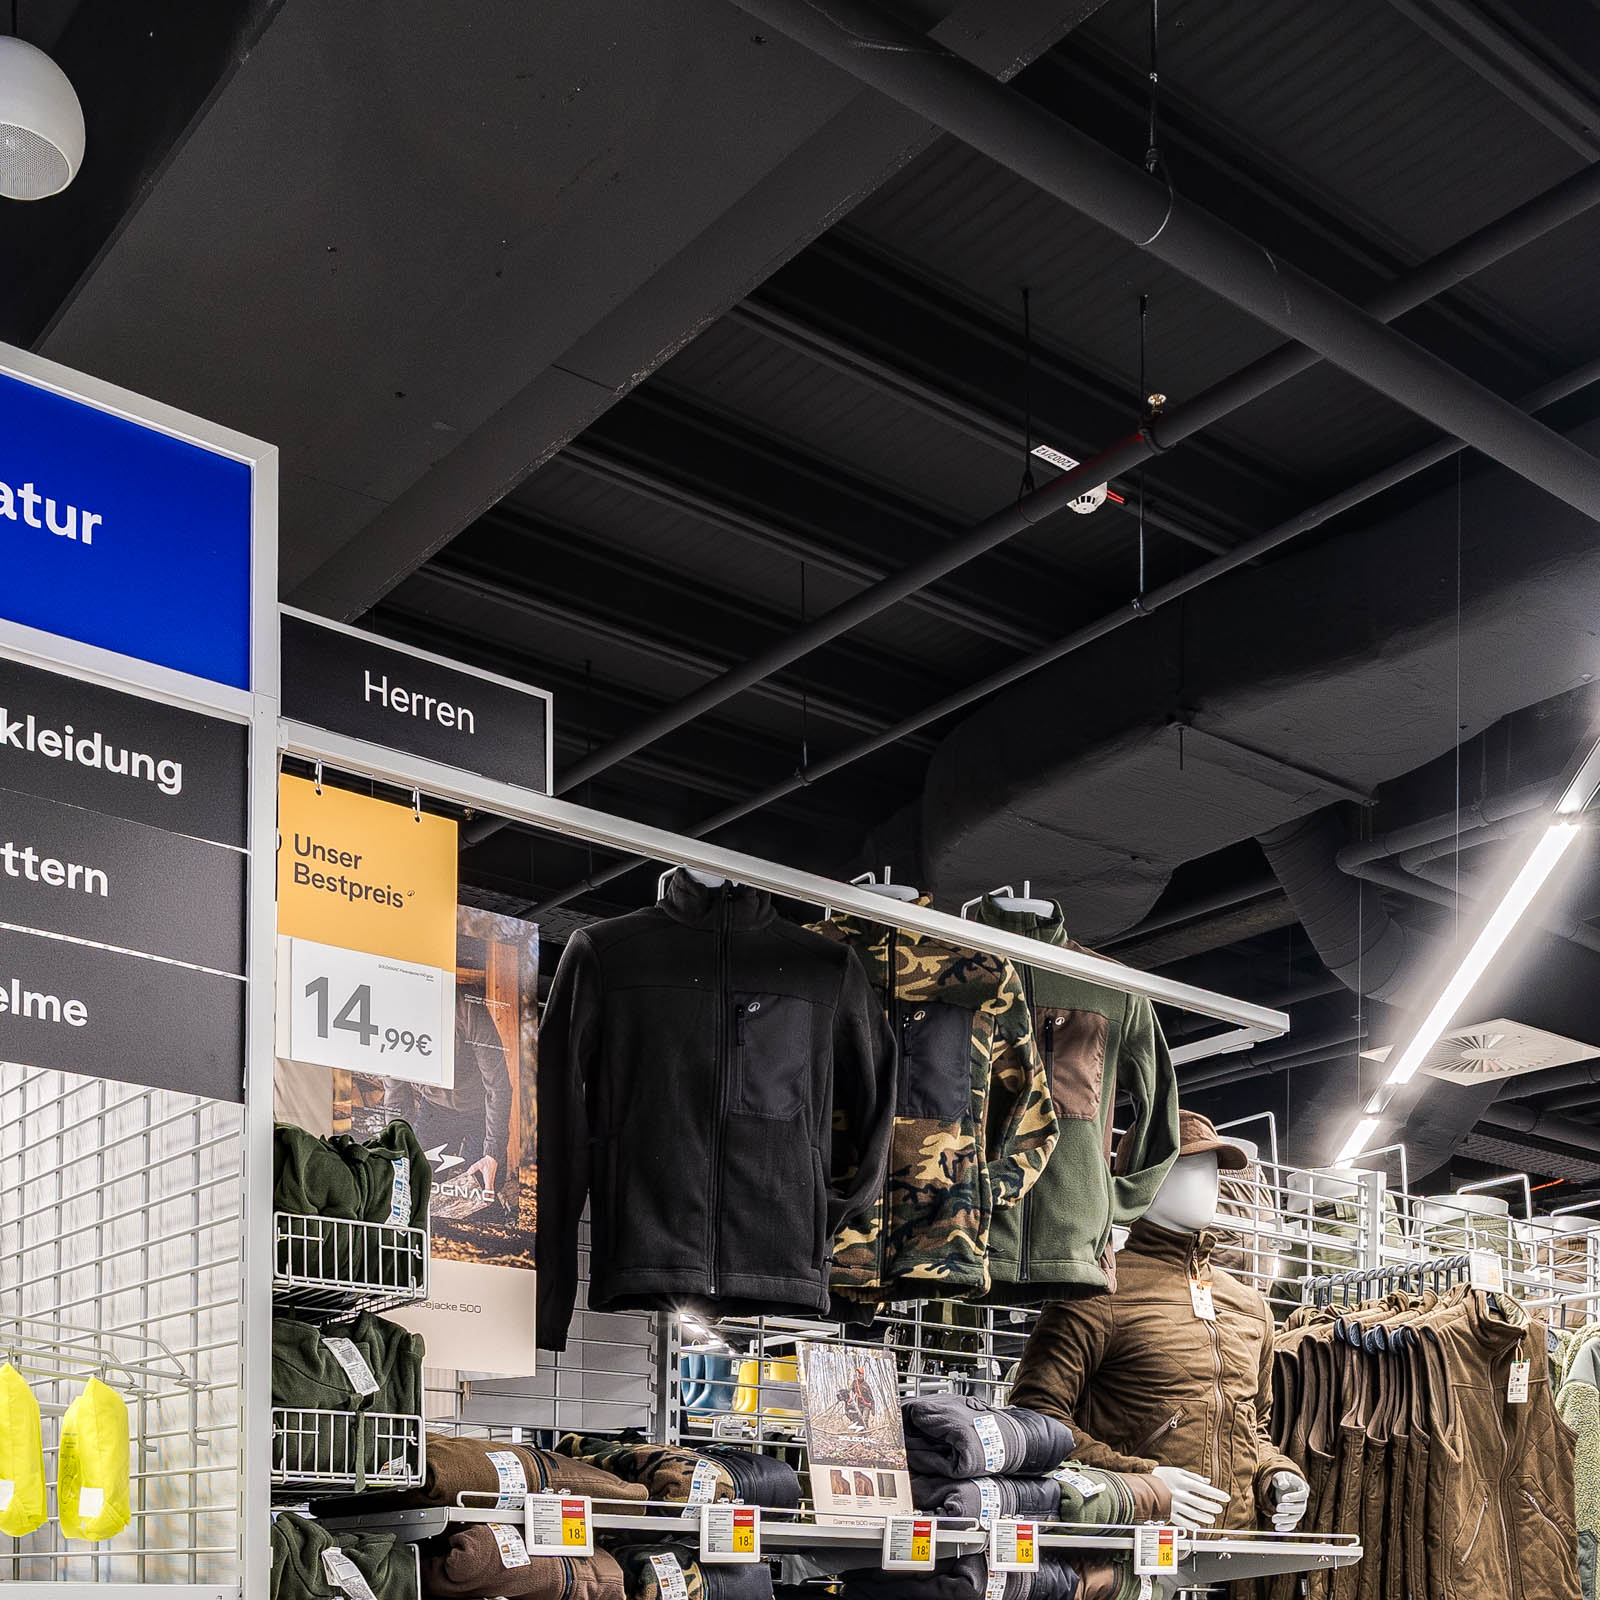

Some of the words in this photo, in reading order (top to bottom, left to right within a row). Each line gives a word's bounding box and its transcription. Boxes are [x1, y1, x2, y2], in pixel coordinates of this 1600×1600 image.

[362, 670, 476, 735] Herren
[294, 833, 363, 871] Unser
[293, 862, 405, 910] Bestpreis
[430, 1181, 496, 1203] OGNAC
[459, 1303, 482, 1314] 500
